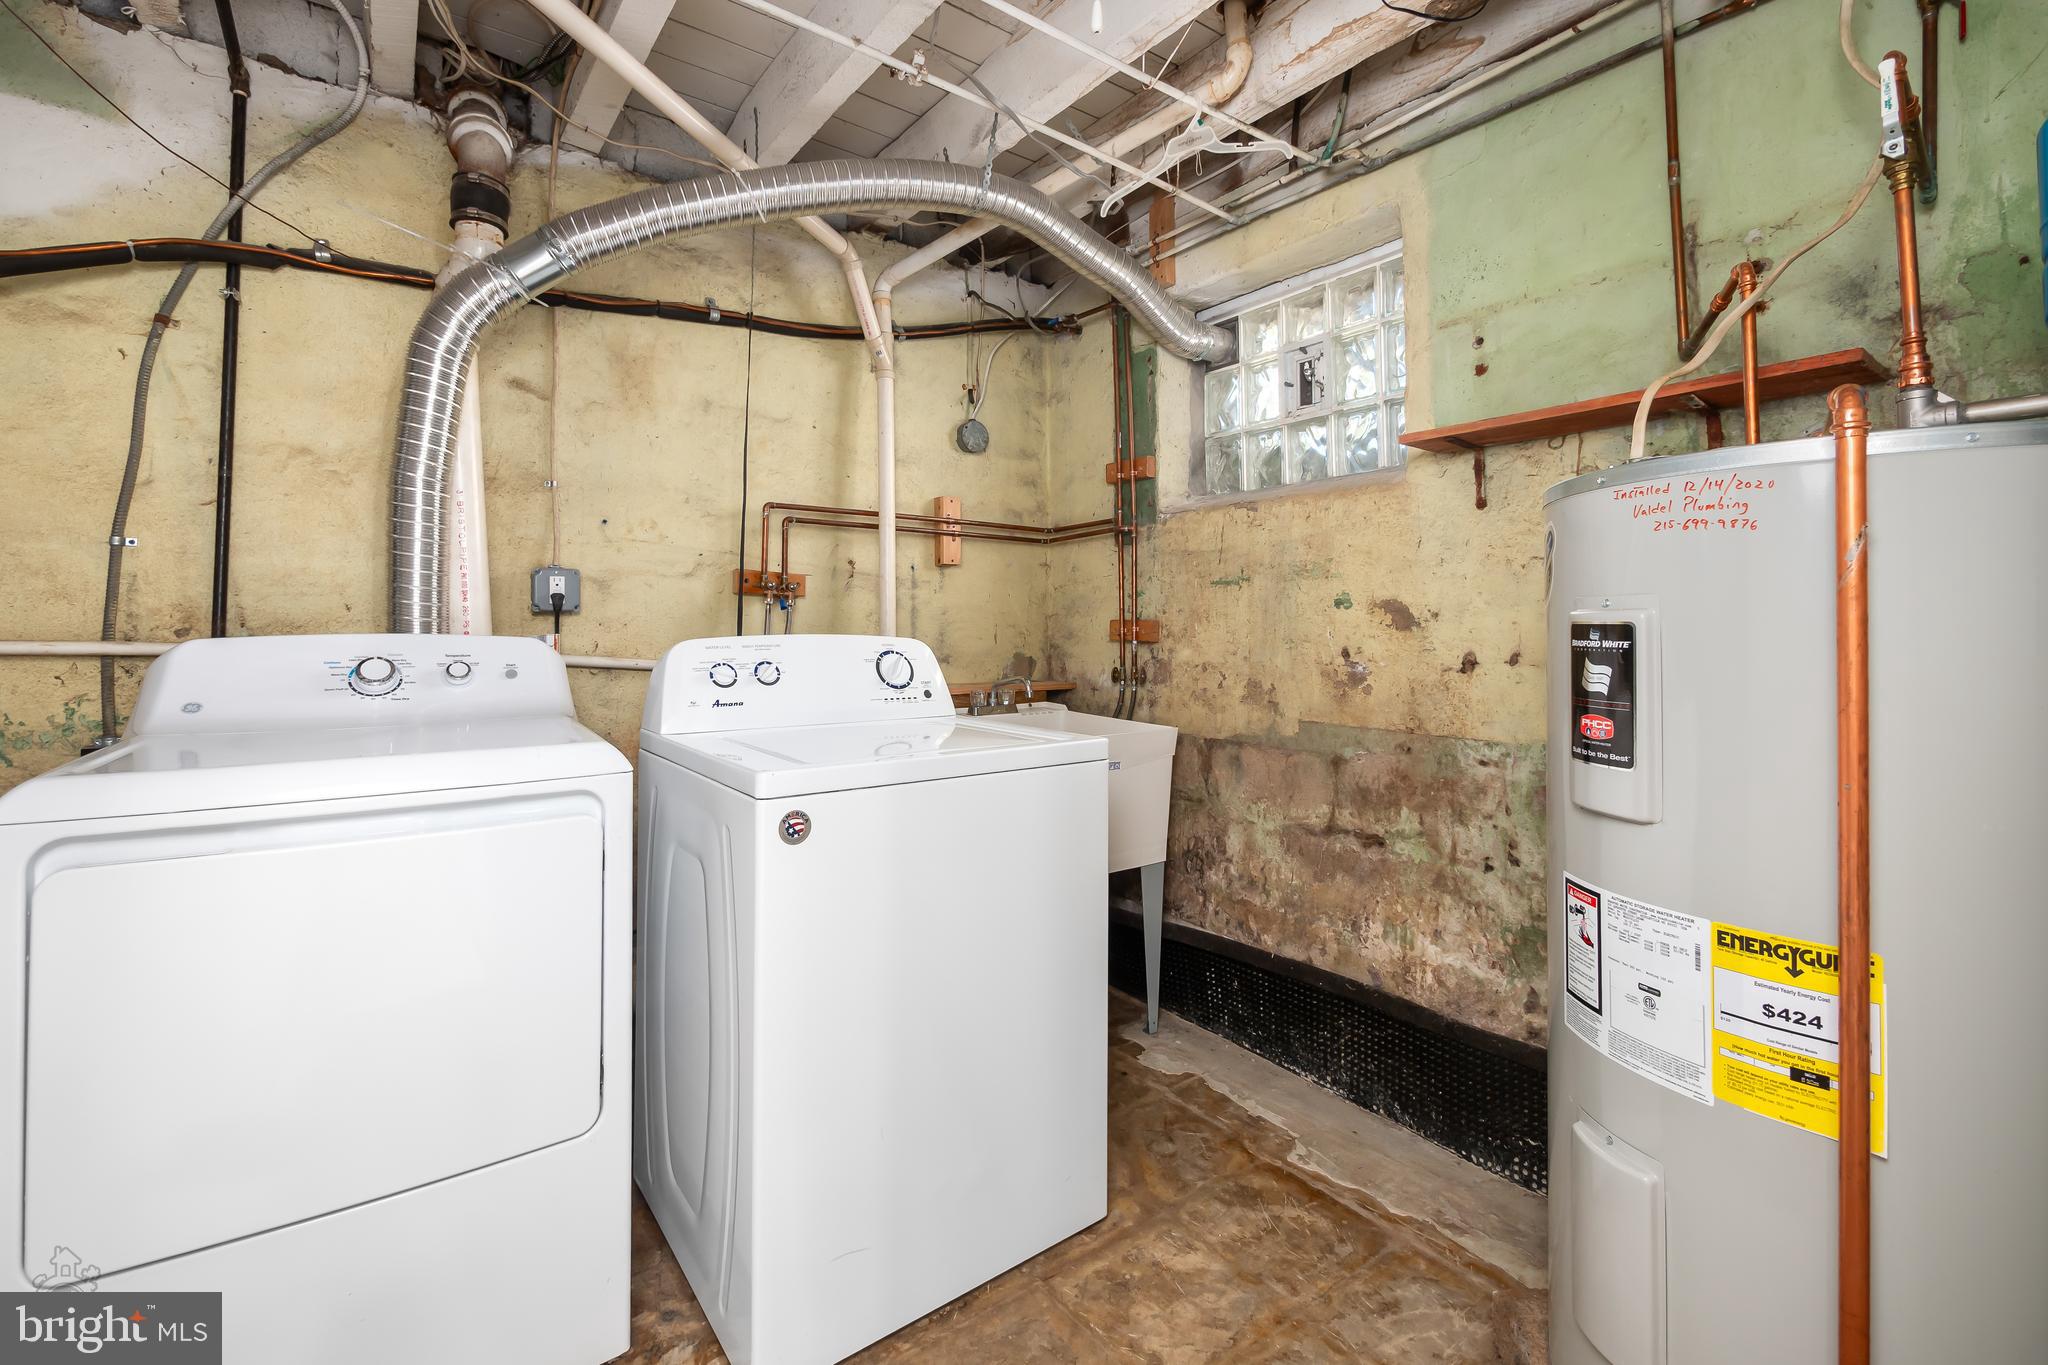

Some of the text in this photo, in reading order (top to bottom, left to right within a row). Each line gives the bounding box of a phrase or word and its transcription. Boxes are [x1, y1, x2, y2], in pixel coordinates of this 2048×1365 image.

[1613, 473, 1775, 501] Installed 12/14/2020
[1633, 495, 1749, 519] Valdel Plumbing
[1654, 519, 1758, 532] 215-699-9876
[1571, 639, 1631, 649] BRADFORD WHITE
[711, 699, 744, 708] Amana
[1582, 718, 1611, 729] PHCC
[1588, 749, 1596, 757] be
[1597, 751, 1608, 760] the
[1609, 753, 1629, 762] Best
[782, 811, 809, 825] AMERICA
[1573, 889, 1592, 904] DANGER
[1656, 910, 1673, 919] WATER
[1673, 916, 1696, 924] HEATER
[1754, 981, 1831, 1003] Estimated Yearly Energy Cost
[1761, 1003, 1824, 1030] $424
[1769, 1048, 1816, 1066] First Hour Rating
